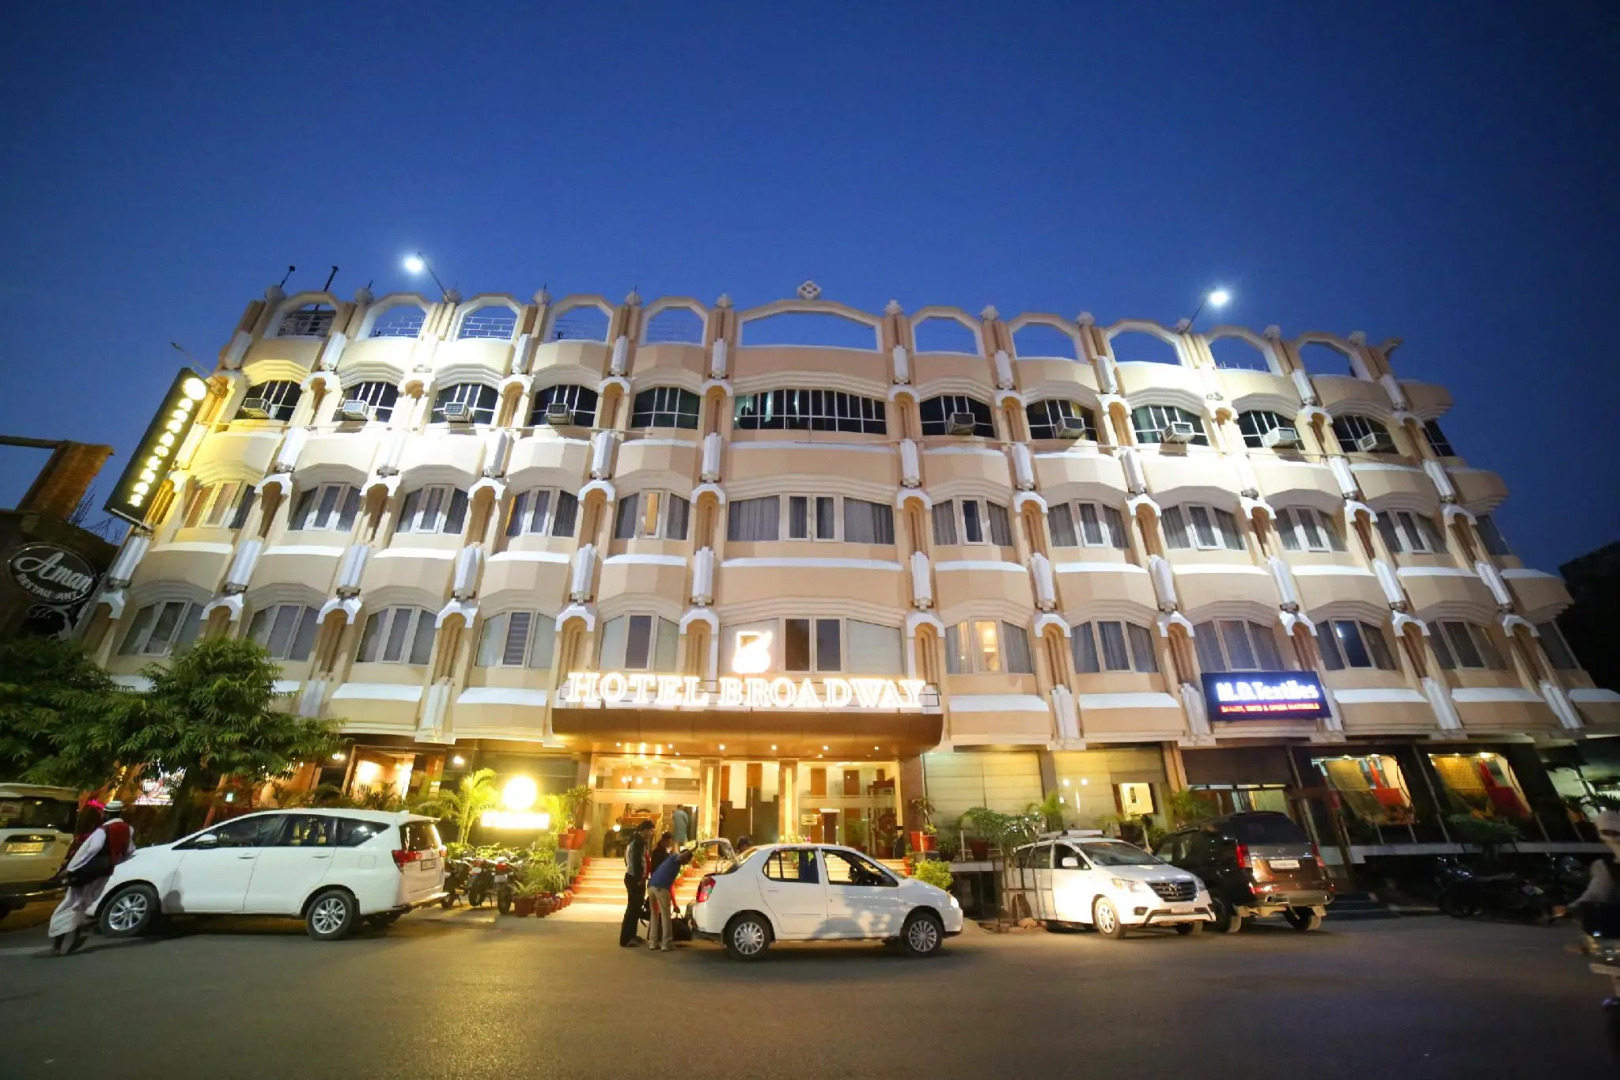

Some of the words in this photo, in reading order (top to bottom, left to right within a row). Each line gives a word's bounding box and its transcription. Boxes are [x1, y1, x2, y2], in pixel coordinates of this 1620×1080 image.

[12, 552, 93, 593] Aman
[565, 672, 709, 706] HOTEL
[717, 677, 926, 708] BROADWAY
